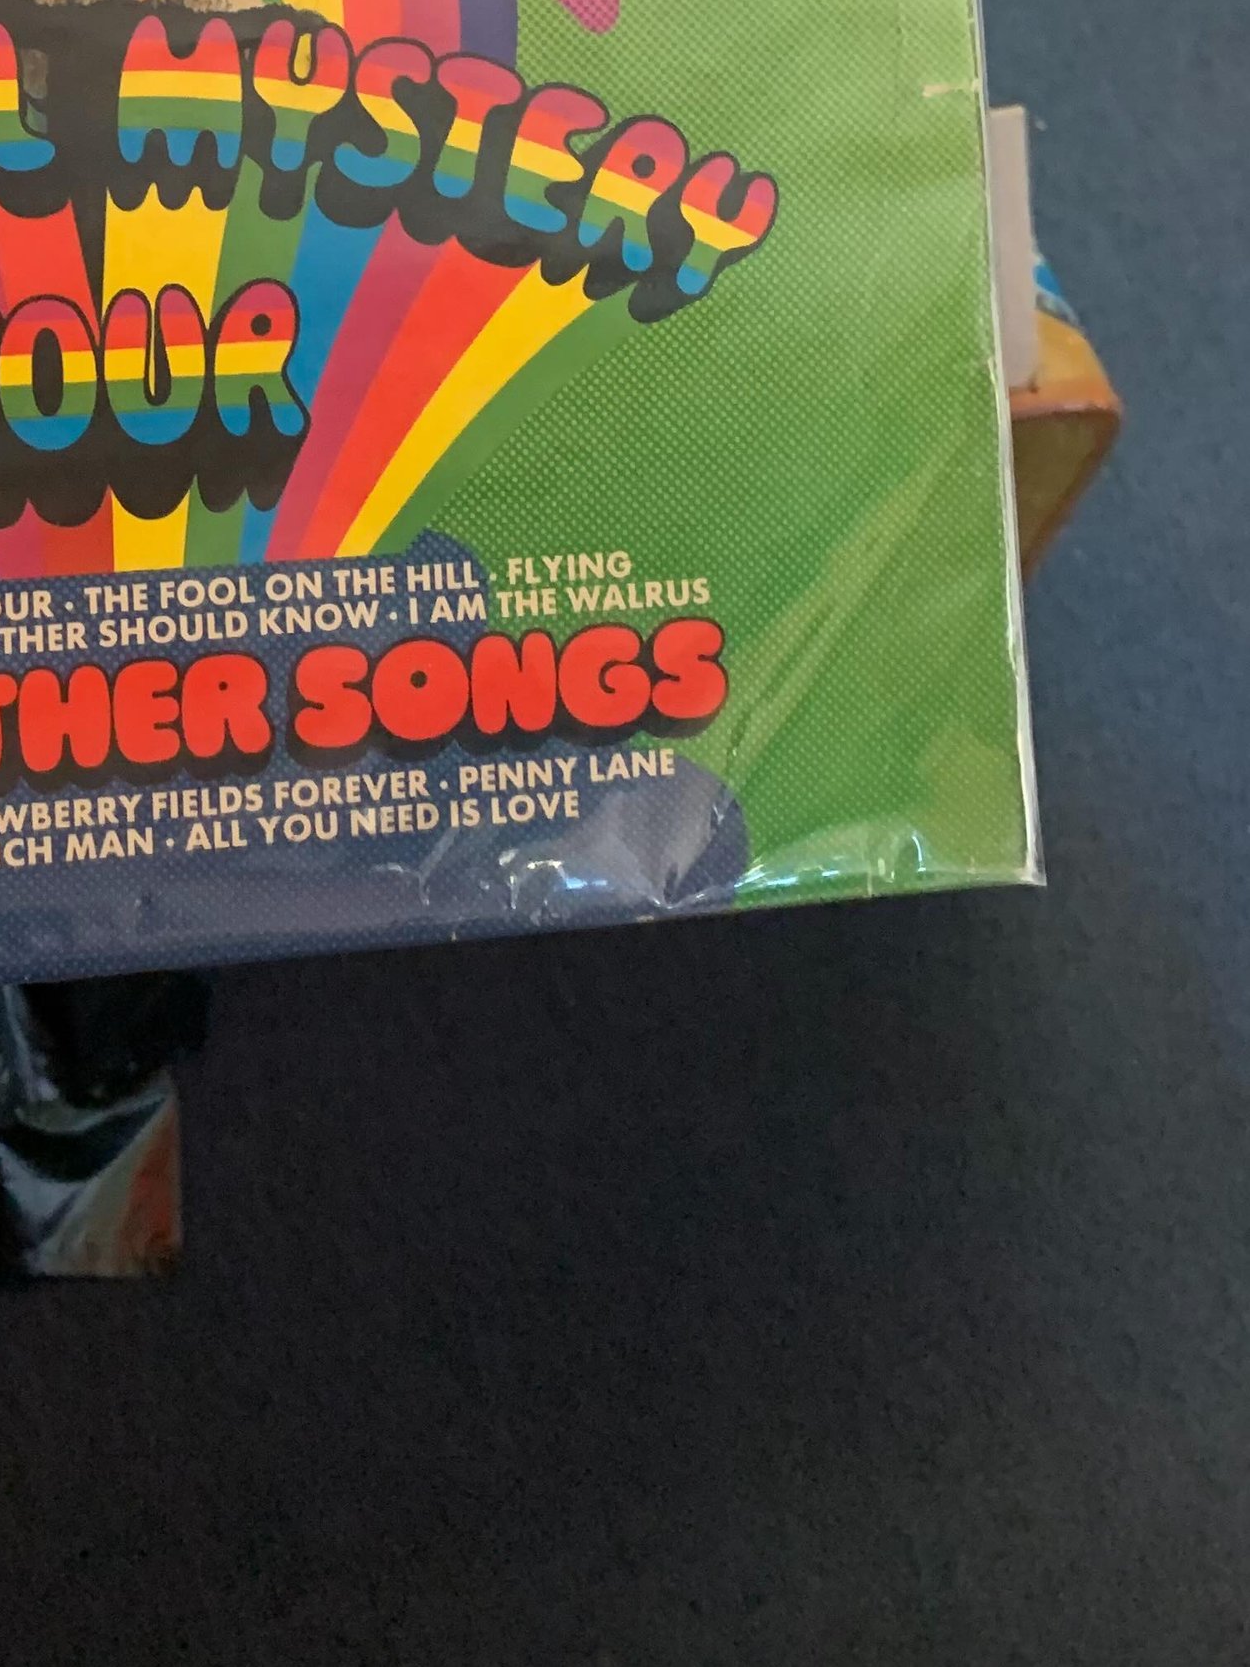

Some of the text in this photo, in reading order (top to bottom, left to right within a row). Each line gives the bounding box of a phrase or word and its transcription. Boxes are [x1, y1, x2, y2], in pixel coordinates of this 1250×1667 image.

[116, 14, 780, 316] MYSTERY
[84, 583, 148, 615] THE
[159, 576, 255, 609] FOOL
[265, 571, 323, 601] ON
[332, 565, 396, 596] THE
[406, 560, 479, 592] HILL
[507, 550, 632, 585] FLYING
[99, 610, 249, 649] SHOULD
[259, 600, 380, 636] KNOW
[408, 597, 419, 624] I
[430, 593, 487, 624] AM
[496, 587, 557, 618] THE
[567, 577, 710, 614] WALRUS
[290, 617, 731, 758] SONGS
[151, 783, 263, 821] FIELDS
[273, 769, 430, 810] FOREVER
[458, 756, 578, 794] PENNY
[588, 748, 676, 783] LANE
[65, 827, 154, 862] MAN
[185, 820, 248, 852] ALL
[257, 811, 339, 845] YOU
[350, 802, 440, 836] NEED
[450, 798, 481, 829] IS
[492, 790, 579, 824] LOVE
